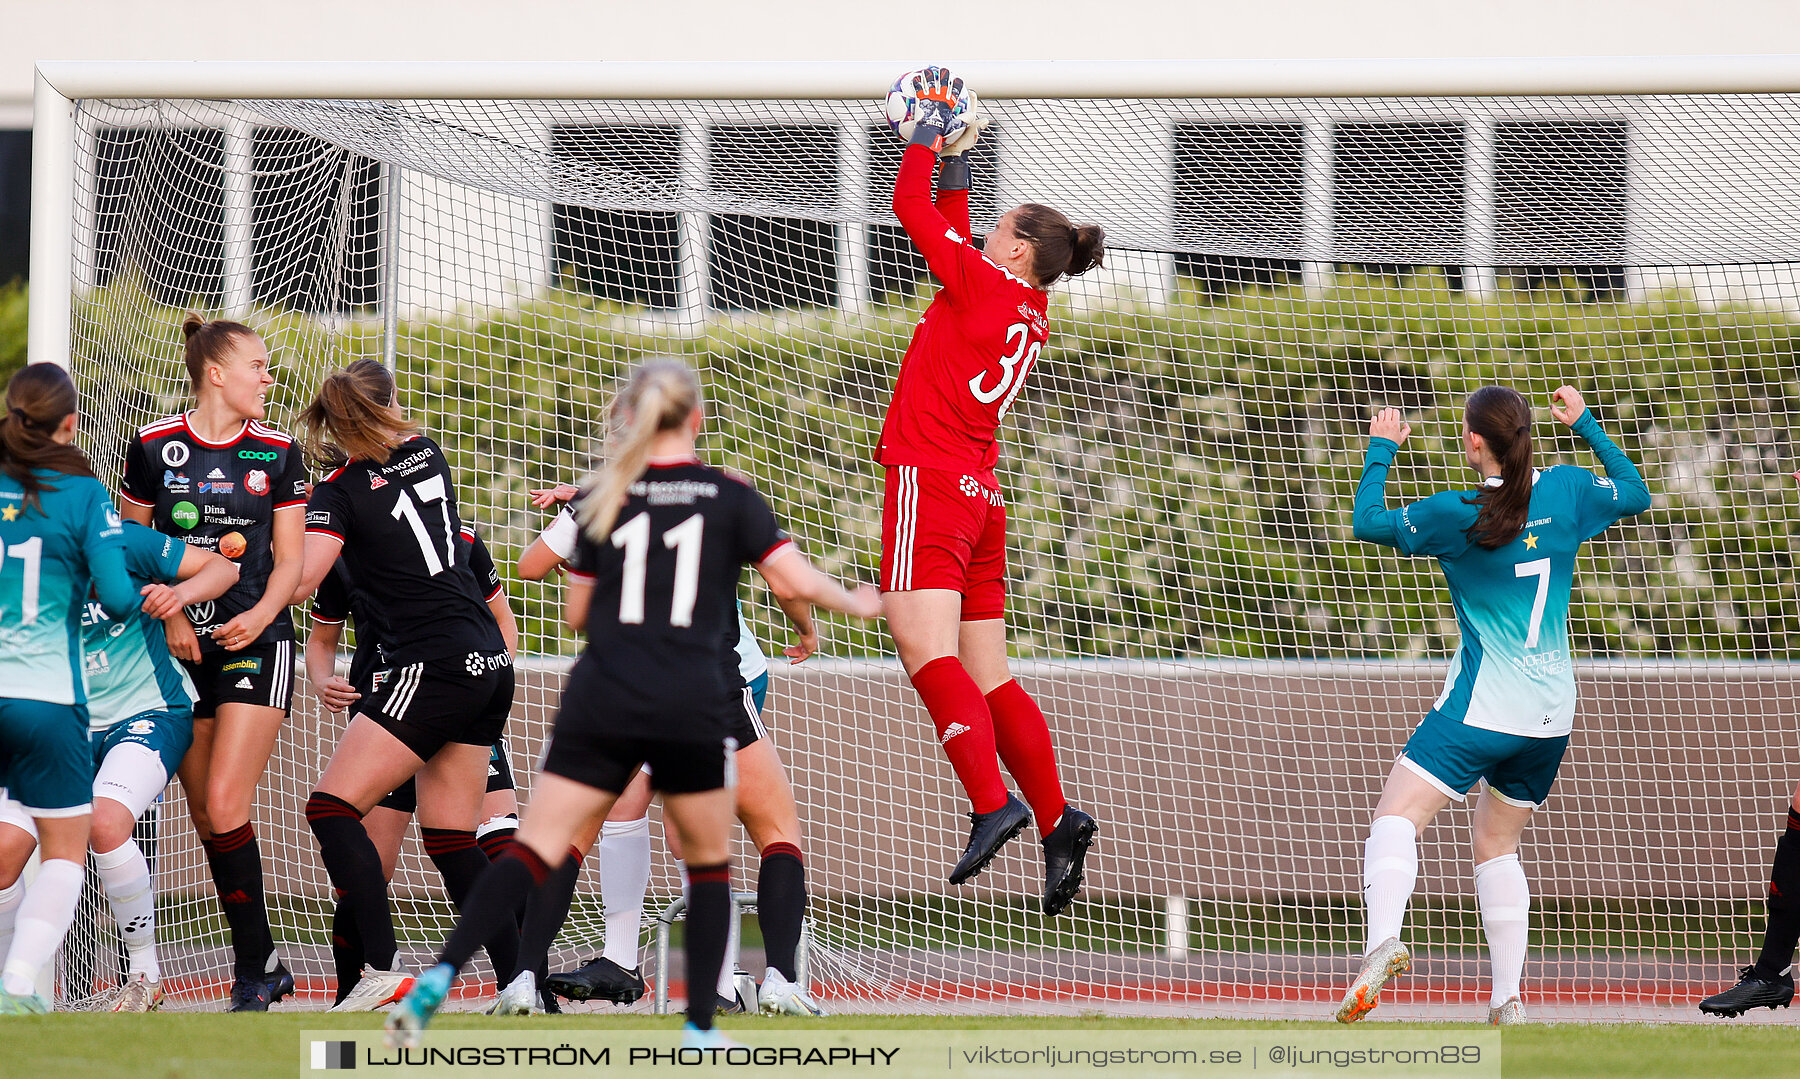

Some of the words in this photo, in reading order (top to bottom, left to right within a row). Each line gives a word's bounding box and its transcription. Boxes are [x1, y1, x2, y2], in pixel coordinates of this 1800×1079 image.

[238, 450, 278, 462] coop
[173, 509, 198, 519] dina
[203, 505, 226, 515] Dina
[390, 473, 455, 577] 17
[611, 511, 704, 628] 11
[1514, 557, 1551, 648] 7
[222, 659, 258, 672] Assemblin
